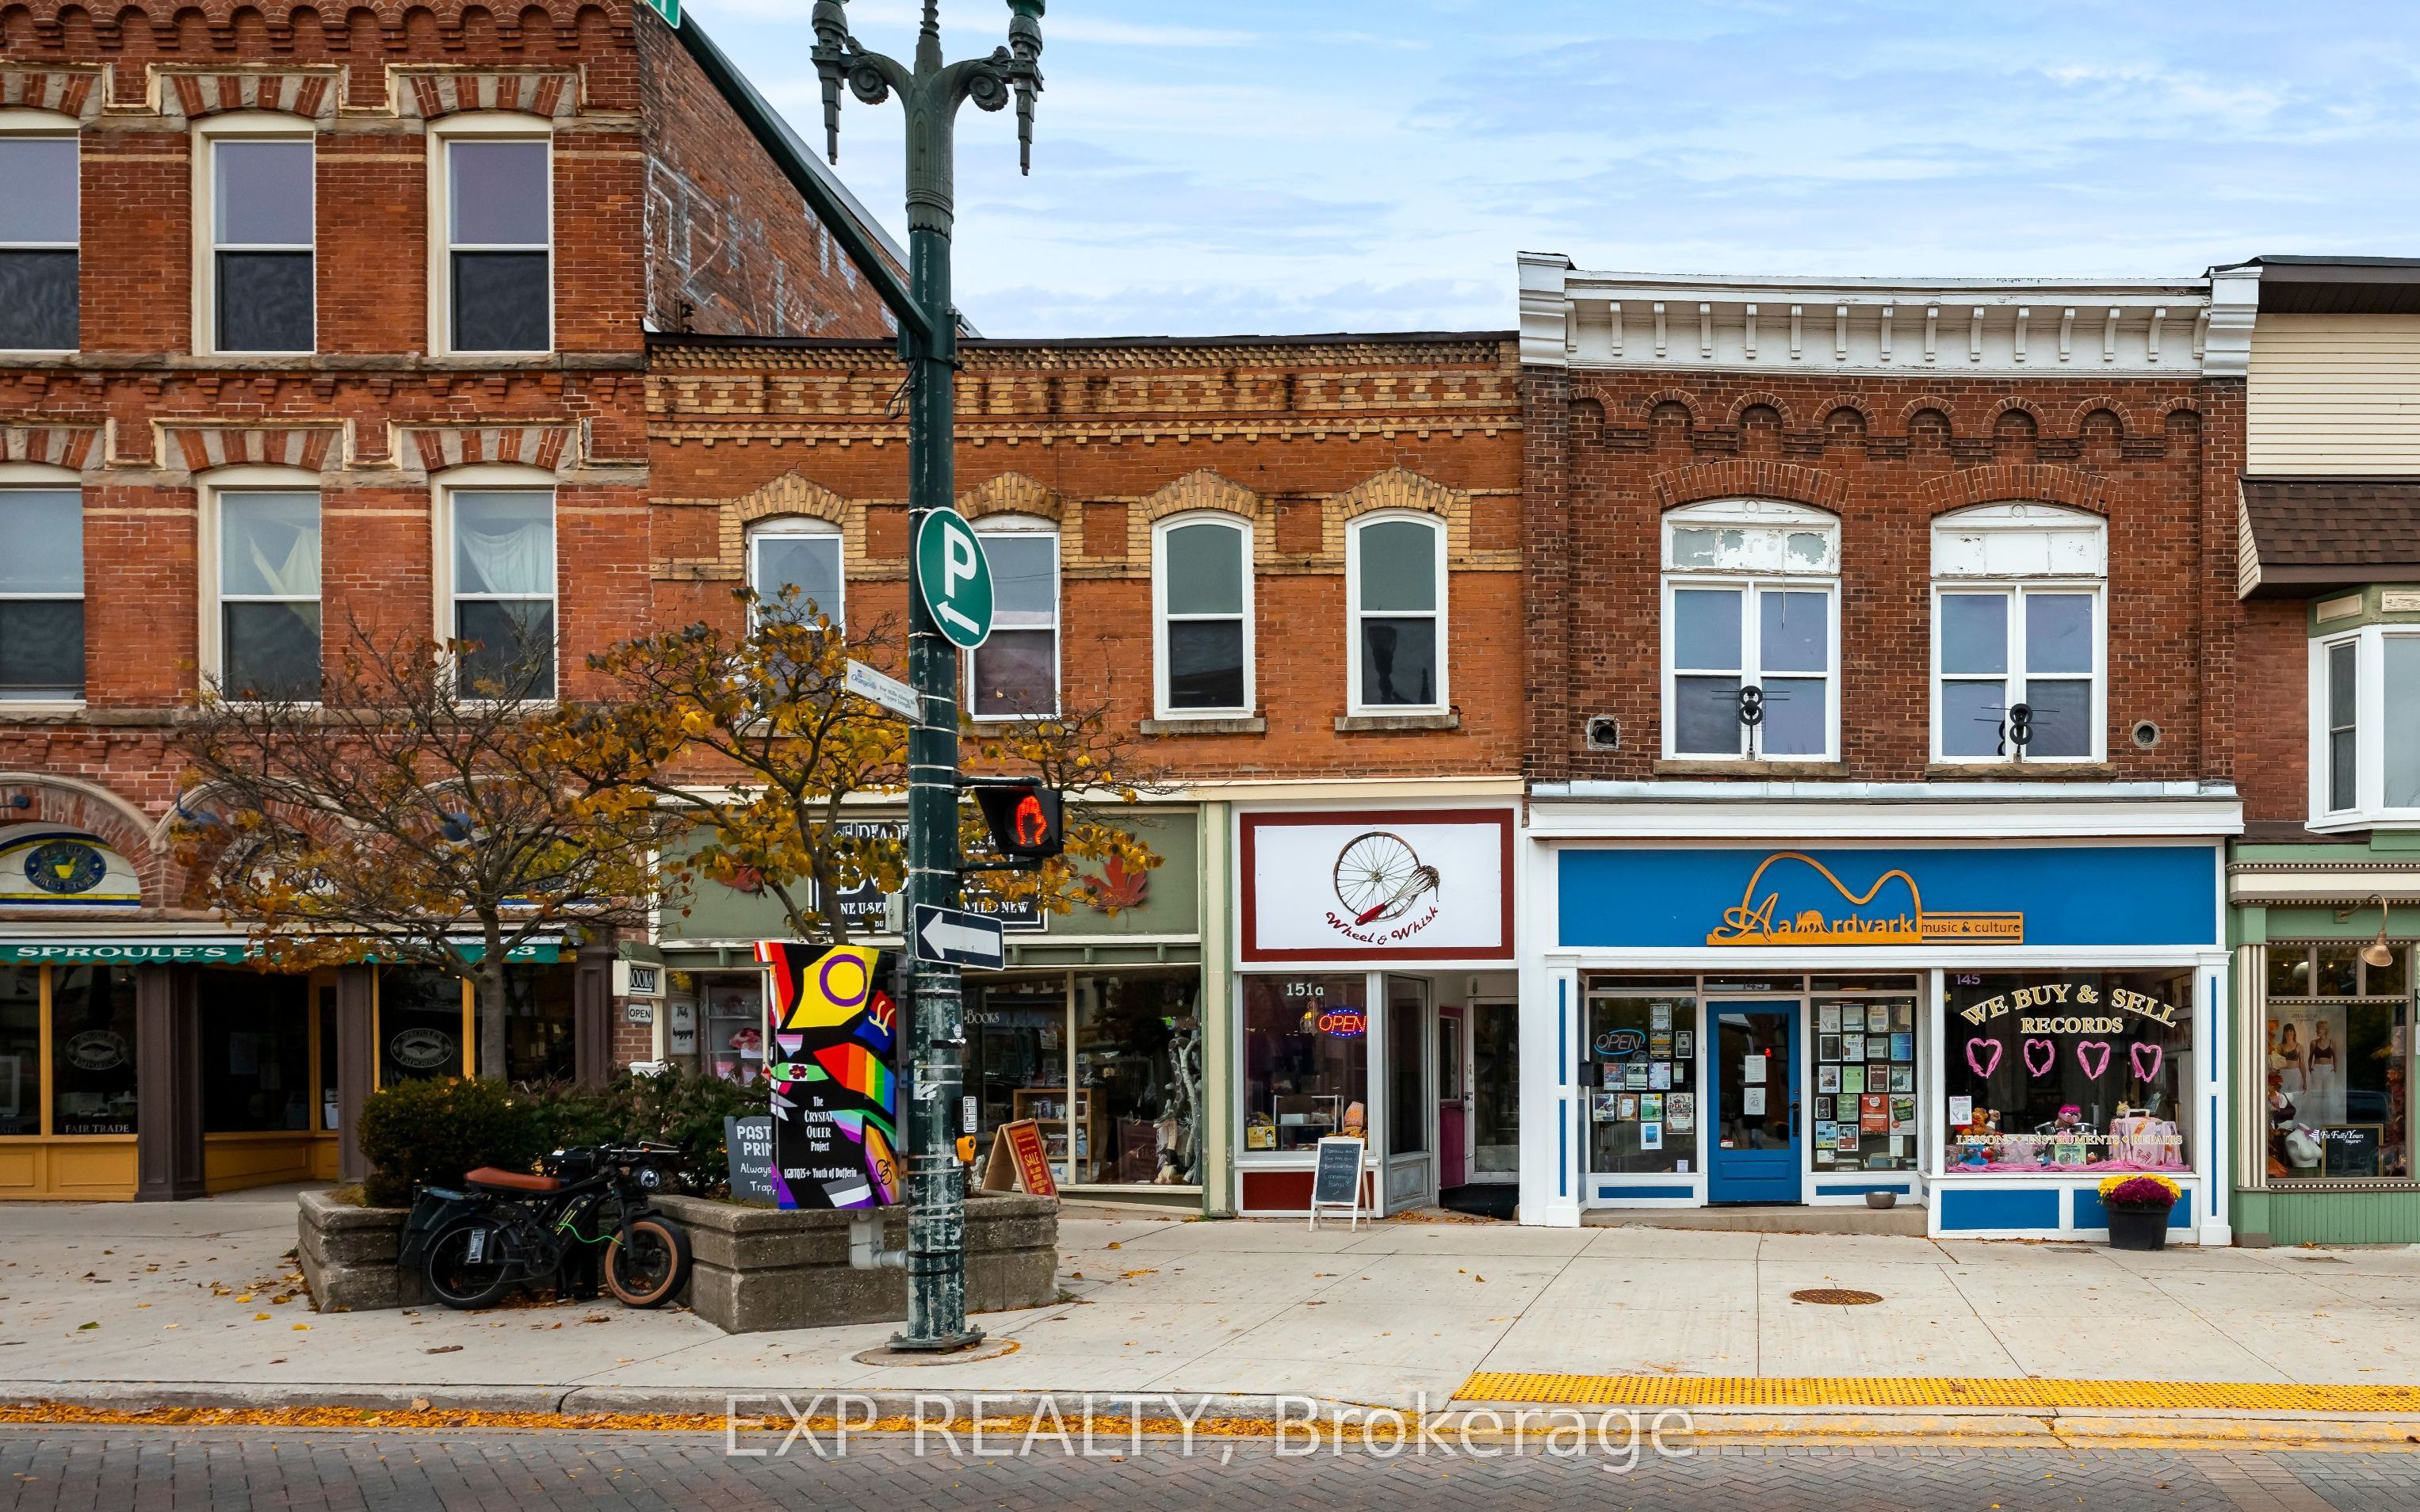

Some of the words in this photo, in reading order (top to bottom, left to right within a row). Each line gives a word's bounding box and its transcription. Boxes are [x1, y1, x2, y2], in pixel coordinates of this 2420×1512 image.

[943, 521, 977, 599] P
[1000, 901, 1030, 914] NEW
[1712, 892, 1916, 943] Aardvark
[1921, 922, 1957, 934] music
[1961, 921, 1971, 934] &
[1974, 922, 2021, 934] culture
[1325, 911, 1375, 944] Wheel
[1378, 935, 1387, 945] &
[1391, 907, 1439, 941] Whisk
[17, 946, 227, 957] SPROULE'S
[1955, 974, 1981, 986] 145
[1286, 982, 1325, 996] 151a
[1960, 995, 2009, 1026] WE
[2011, 983, 2072, 1010] BUY
[2077, 984, 2099, 1004] &
[2111, 988, 2177, 1028] SELL
[629, 1009, 651, 1018] OPEN
[1318, 1015, 1367, 1032] OPEN
[2020, 1017, 2124, 1033] RECORDS
[1596, 1034, 1642, 1050] OPEN
[812, 1096, 824, 1107] The
[65, 1124, 90, 1133] FAIR
[93, 1124, 130, 1133] TRADE
[806, 1125, 832, 1139] QUEER
[810, 1141, 830, 1153] Project
[1955, 1135, 2015, 1146] LESSONS
[2026, 1135, 2120, 1146] INSTRUMENTS
[2131, 1135, 2183, 1146] REPAIRS
[1024, 1151, 1041, 1167] SALE
[740, 1163, 772, 1178] Always
[784, 1167, 812, 1179] LGBTQ2S+
[812, 1167, 828, 1178] Youth
[829, 1167, 835, 1179] of
[835, 1167, 858, 1179] Dufferin
